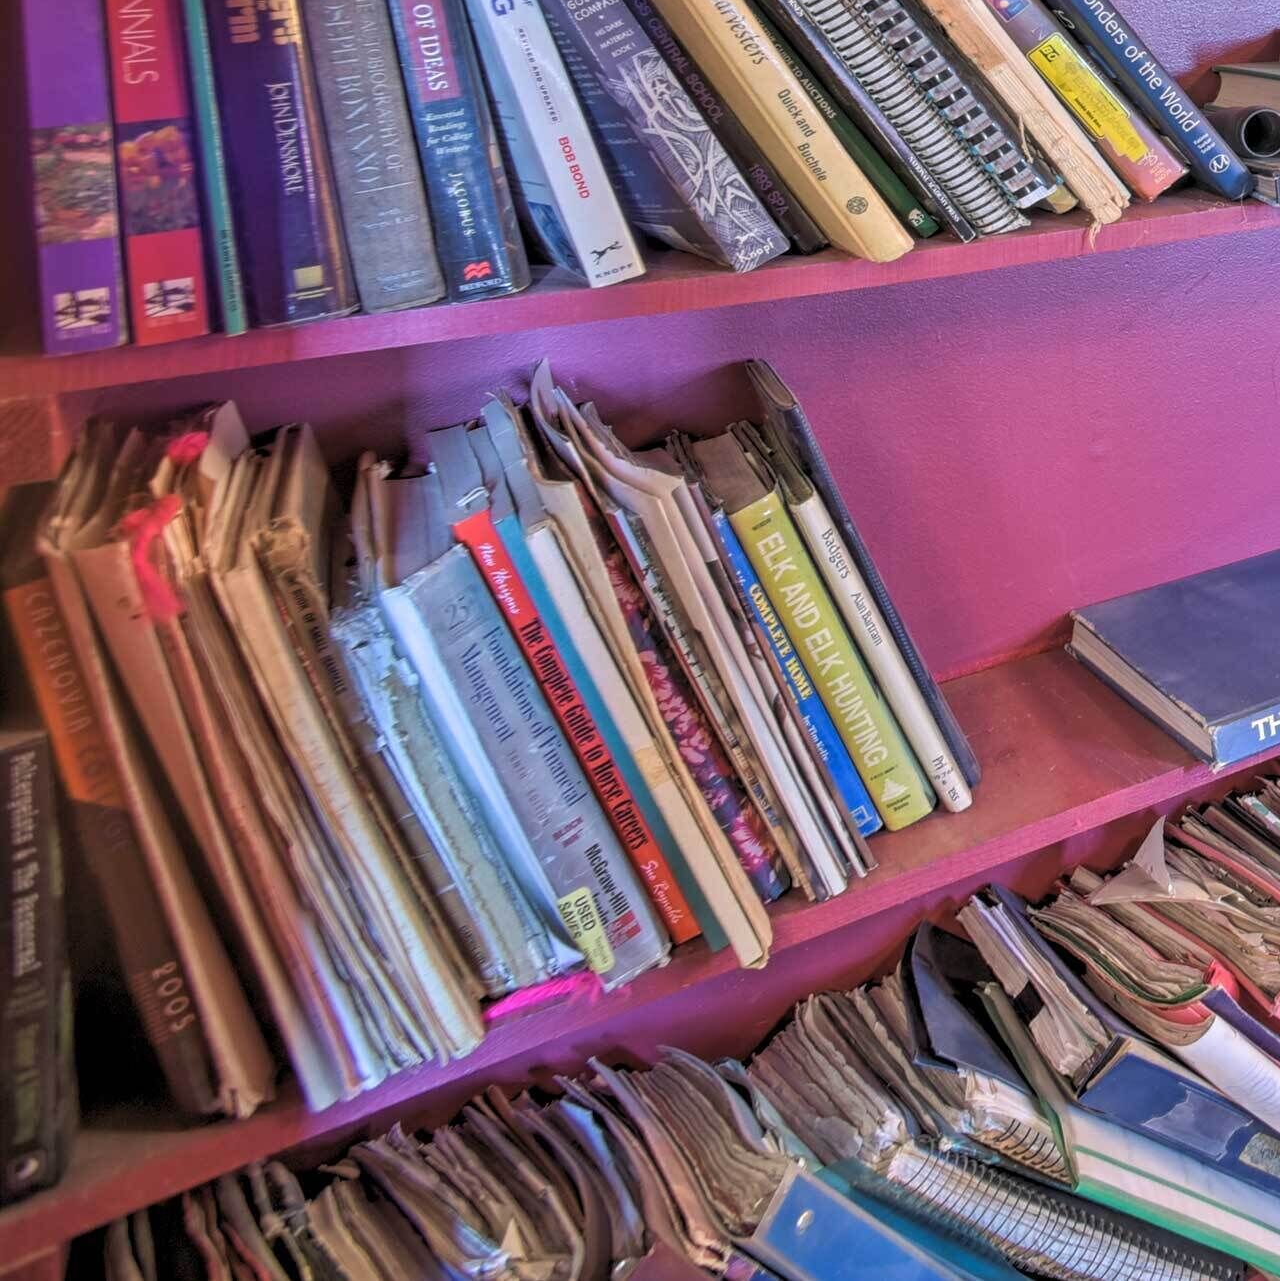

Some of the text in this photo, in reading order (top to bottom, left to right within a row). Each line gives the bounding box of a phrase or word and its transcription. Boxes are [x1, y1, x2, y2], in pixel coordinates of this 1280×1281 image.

[412, 4, 437, 28] OF
[600, 29, 635, 50] MATERIALS
[606, 20, 625, 34] DARK
[360, 16, 402, 155] AUTOBIOGRAPHY
[418, 34, 450, 92] IDEAS
[1124, 38, 1147, 66] of
[1140, 60, 1163, 89] the
[1159, 86, 1200, 133] World
[425, 108, 465, 121] Essential
[428, 120, 467, 135] Readings
[442, 130, 474, 146] College
[778, 88, 828, 183] Quick and Buchele
[558, 136, 591, 200] BOB BOND
[735, 238, 775, 264] Knopf
[749, 582, 814, 701] COMPLETE HOME
[756, 533, 890, 770] ELK AND ELK HUNTING
[460, 642, 517, 744] Management
[482, 626, 588, 807] Foundations of Financial
[519, 615, 650, 851] The Complete Guide to Horse Careers
[584, 843, 631, 916] McGraw-Hill
[558, 900, 582, 940] SAVES
[573, 894, 597, 932] USED
